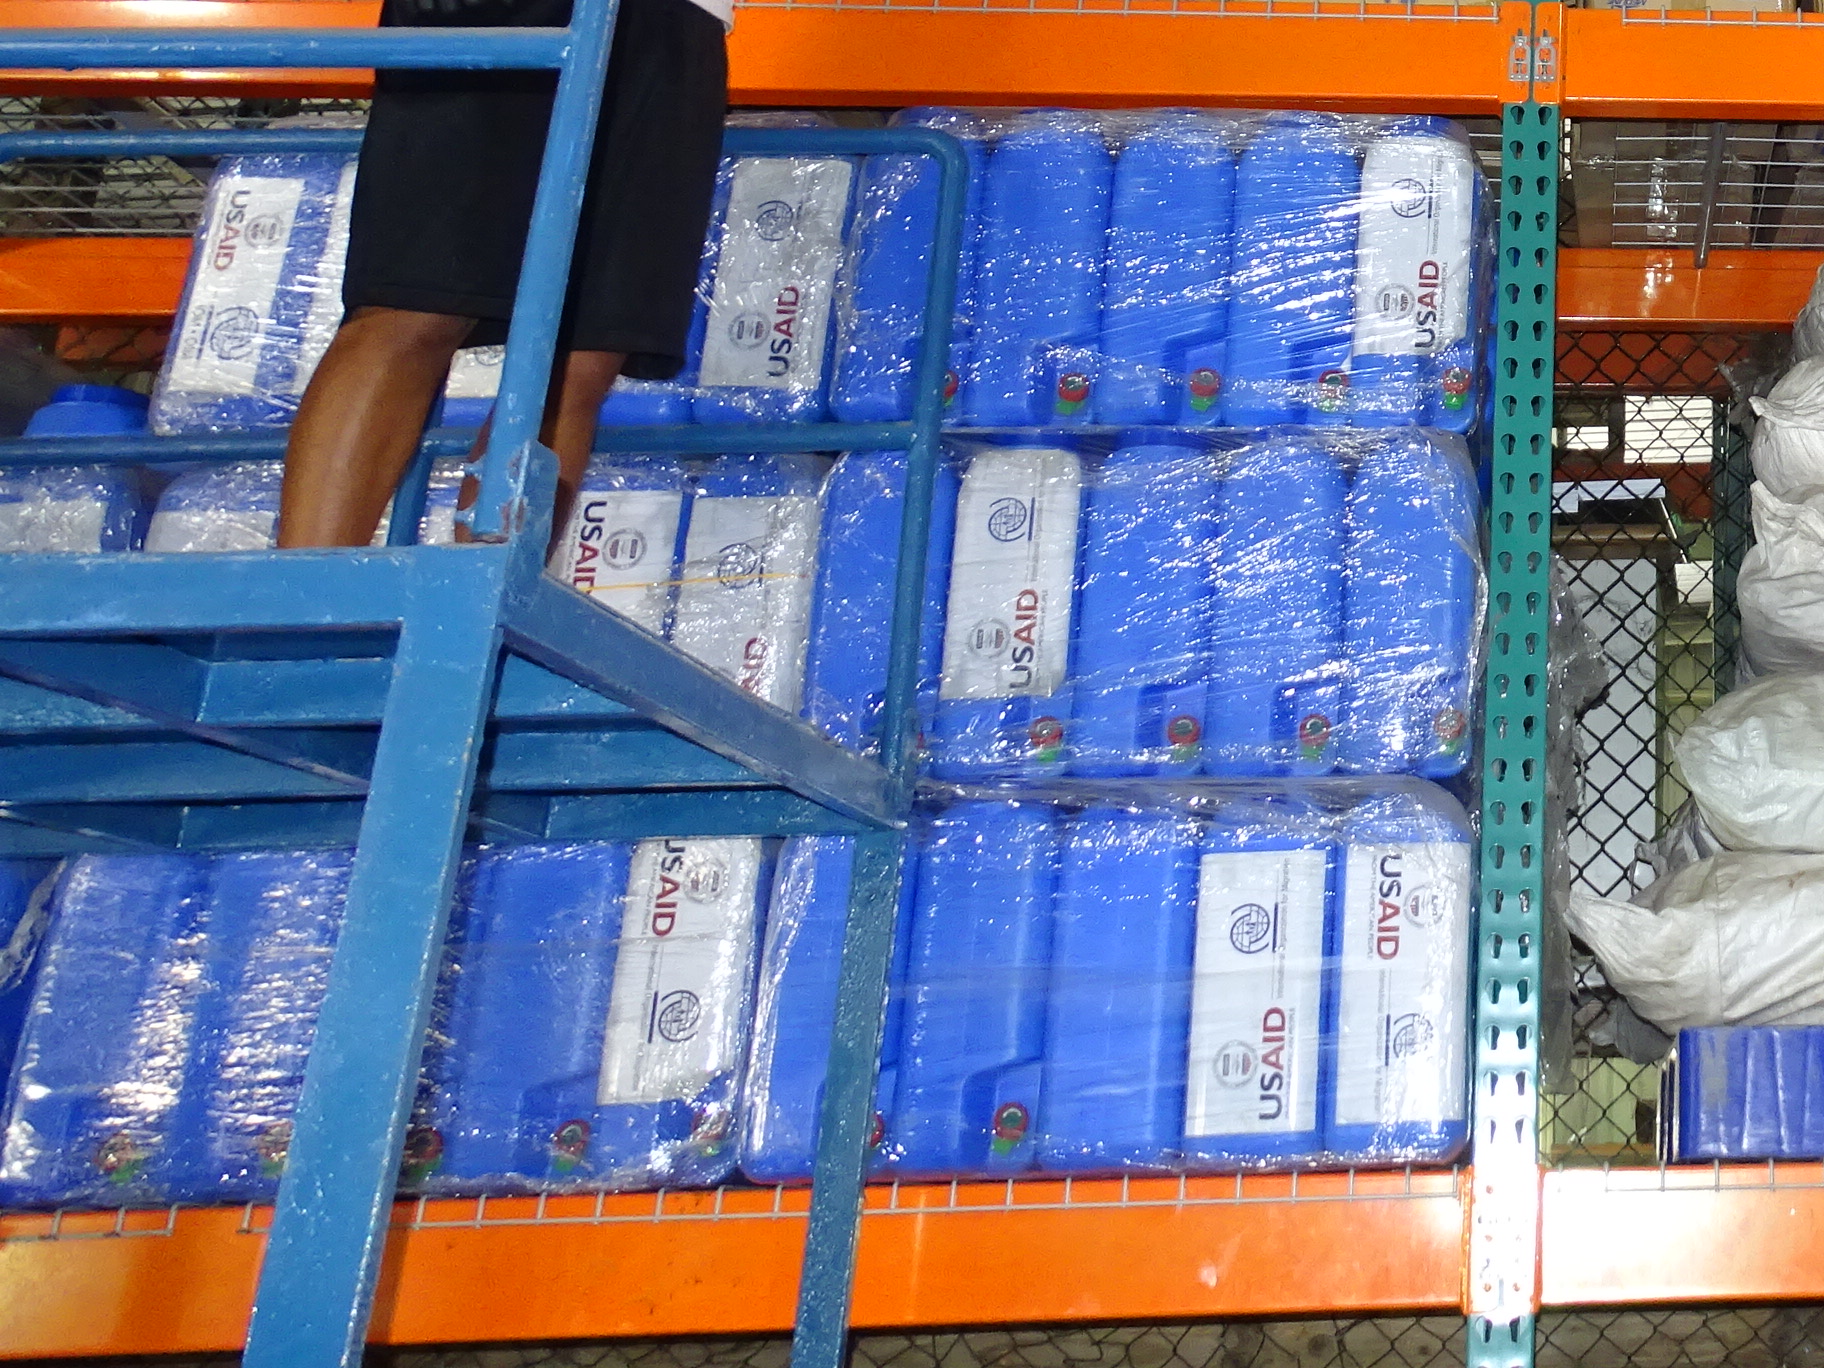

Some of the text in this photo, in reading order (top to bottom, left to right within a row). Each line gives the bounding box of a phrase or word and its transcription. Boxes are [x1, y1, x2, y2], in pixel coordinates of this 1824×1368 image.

[213, 190, 251, 271] USAID
[767, 285, 800, 379] USAID
[1415, 260, 1440, 348] USAID
[1009, 589, 1039, 689] USAID
[1376, 854, 1402, 960] USAID
[1259, 1007, 1286, 1120] USAID
